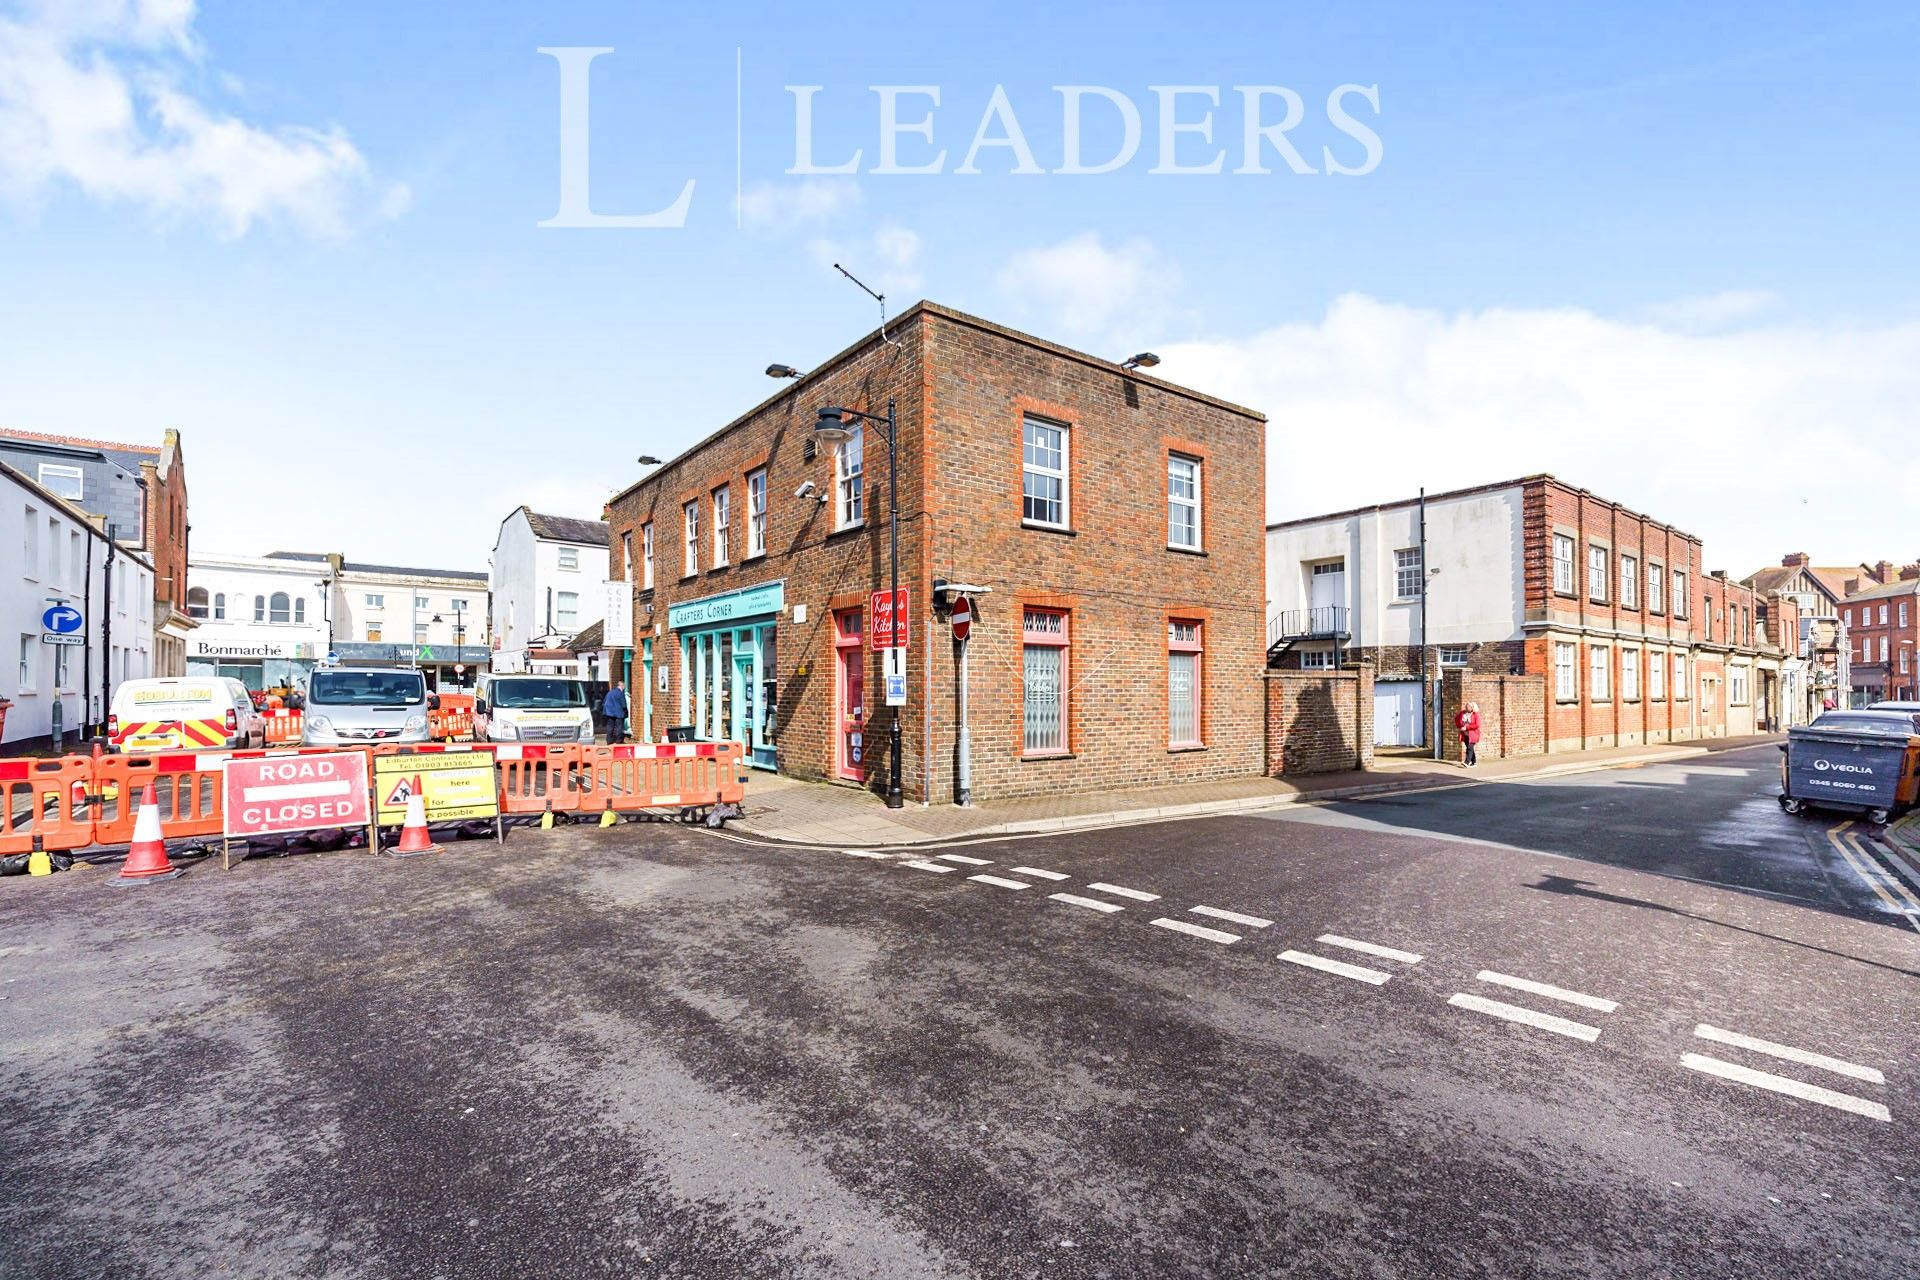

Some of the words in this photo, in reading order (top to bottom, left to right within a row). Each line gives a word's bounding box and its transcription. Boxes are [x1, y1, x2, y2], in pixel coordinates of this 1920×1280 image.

[707, 603, 732, 618] CORNER
[198, 642, 281, 656] Bonmarché
[259, 761, 335, 781] ROAD
[1831, 764, 1873, 774] VEOLIA
[242, 801, 353, 824] CLOSED
[437, 809, 474, 818] possible
